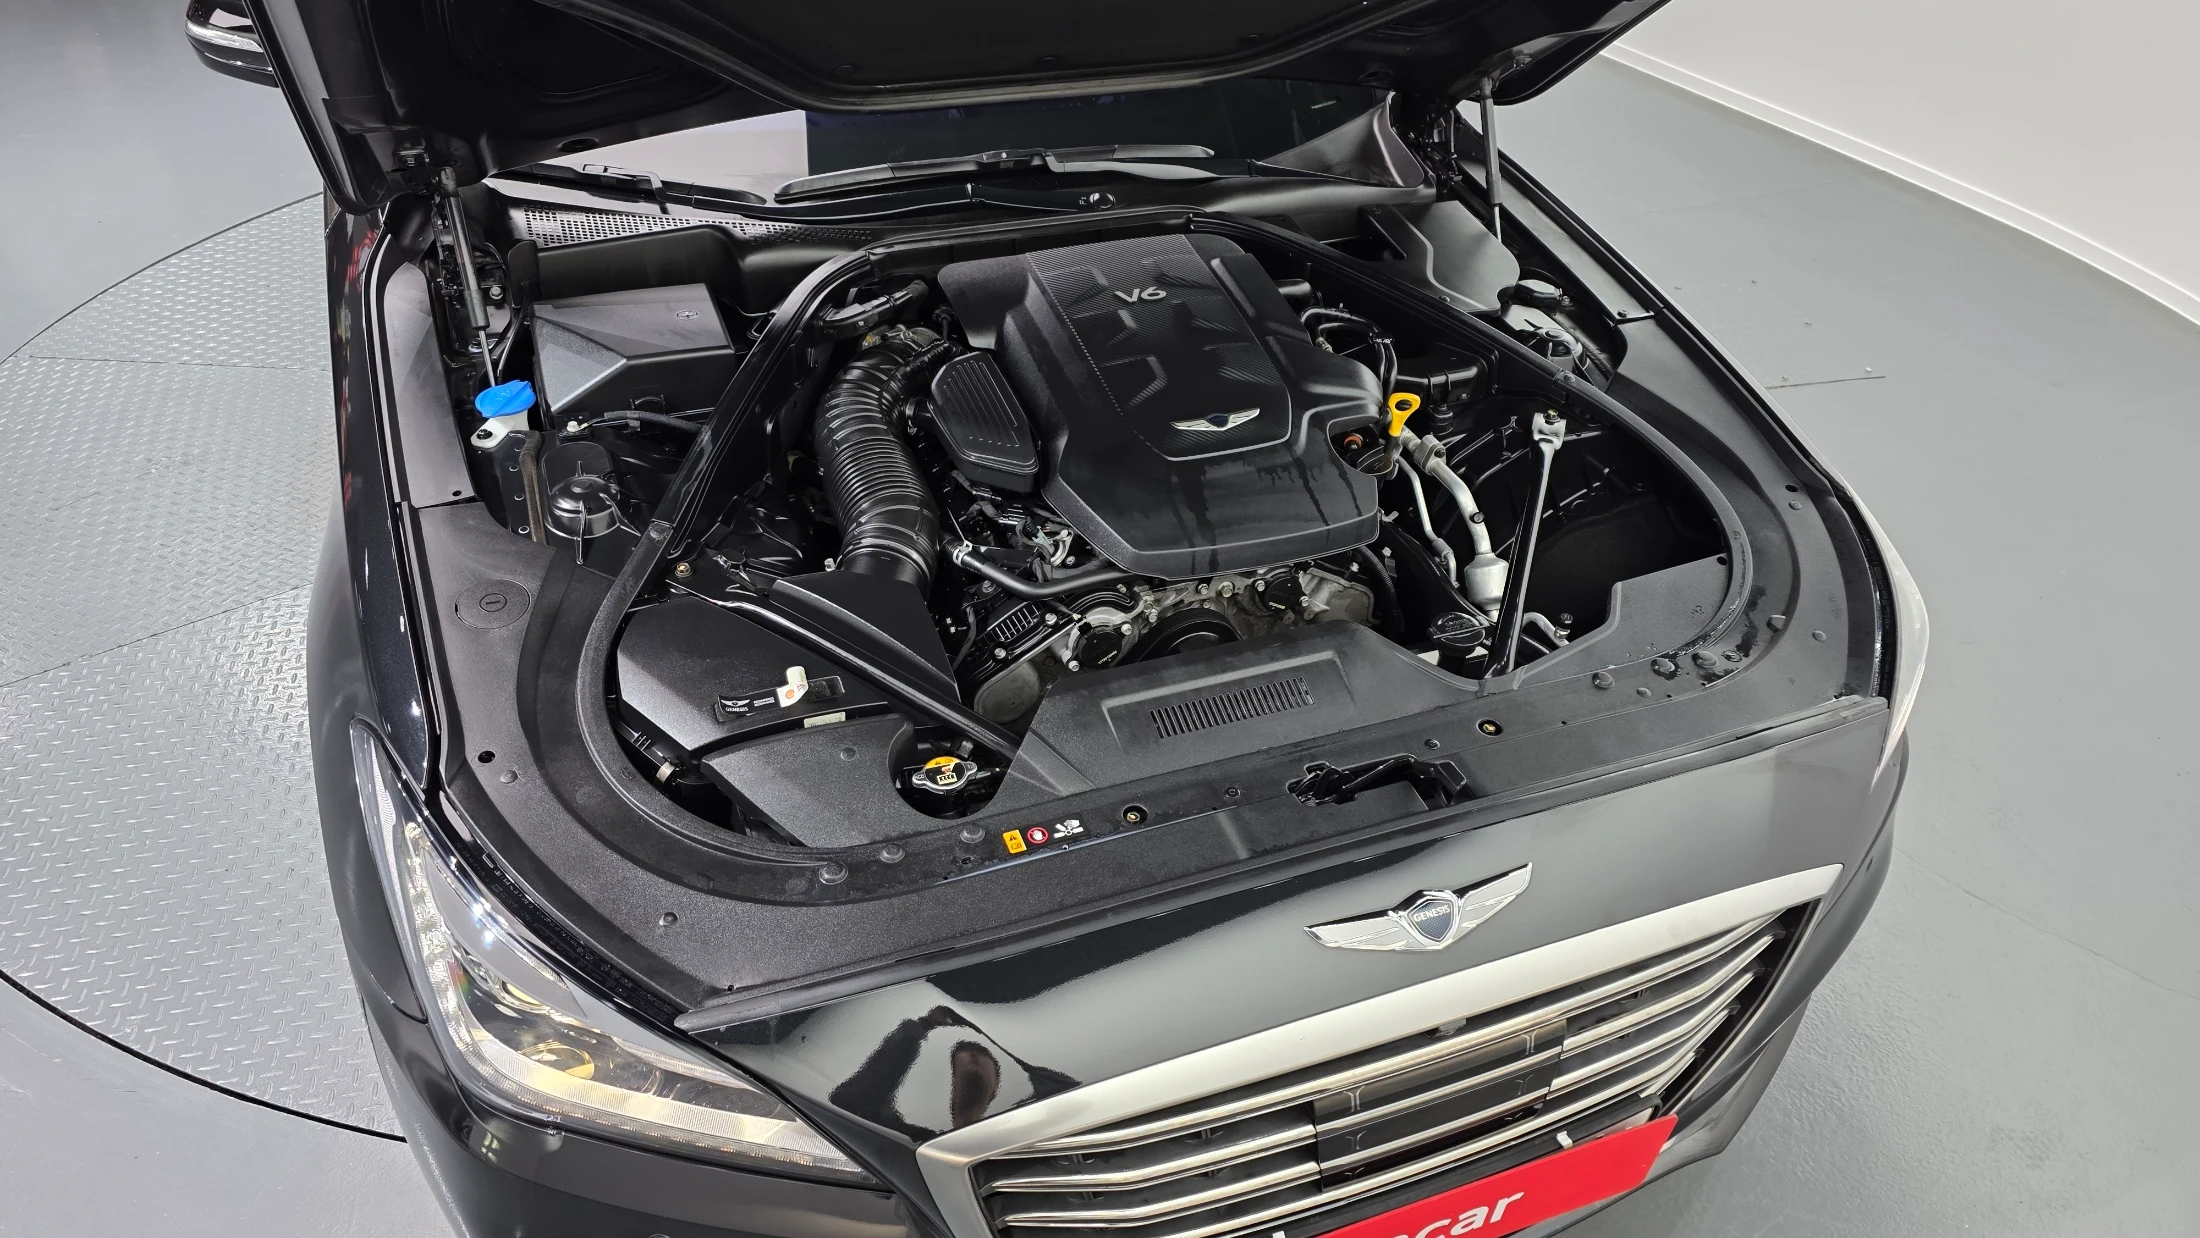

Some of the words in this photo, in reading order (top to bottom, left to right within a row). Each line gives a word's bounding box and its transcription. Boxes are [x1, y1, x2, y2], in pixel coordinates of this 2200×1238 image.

[1114, 286, 1167, 302] V6
[1413, 904, 1451, 922] GENESIS
[1393, 1191, 1525, 1238] car
